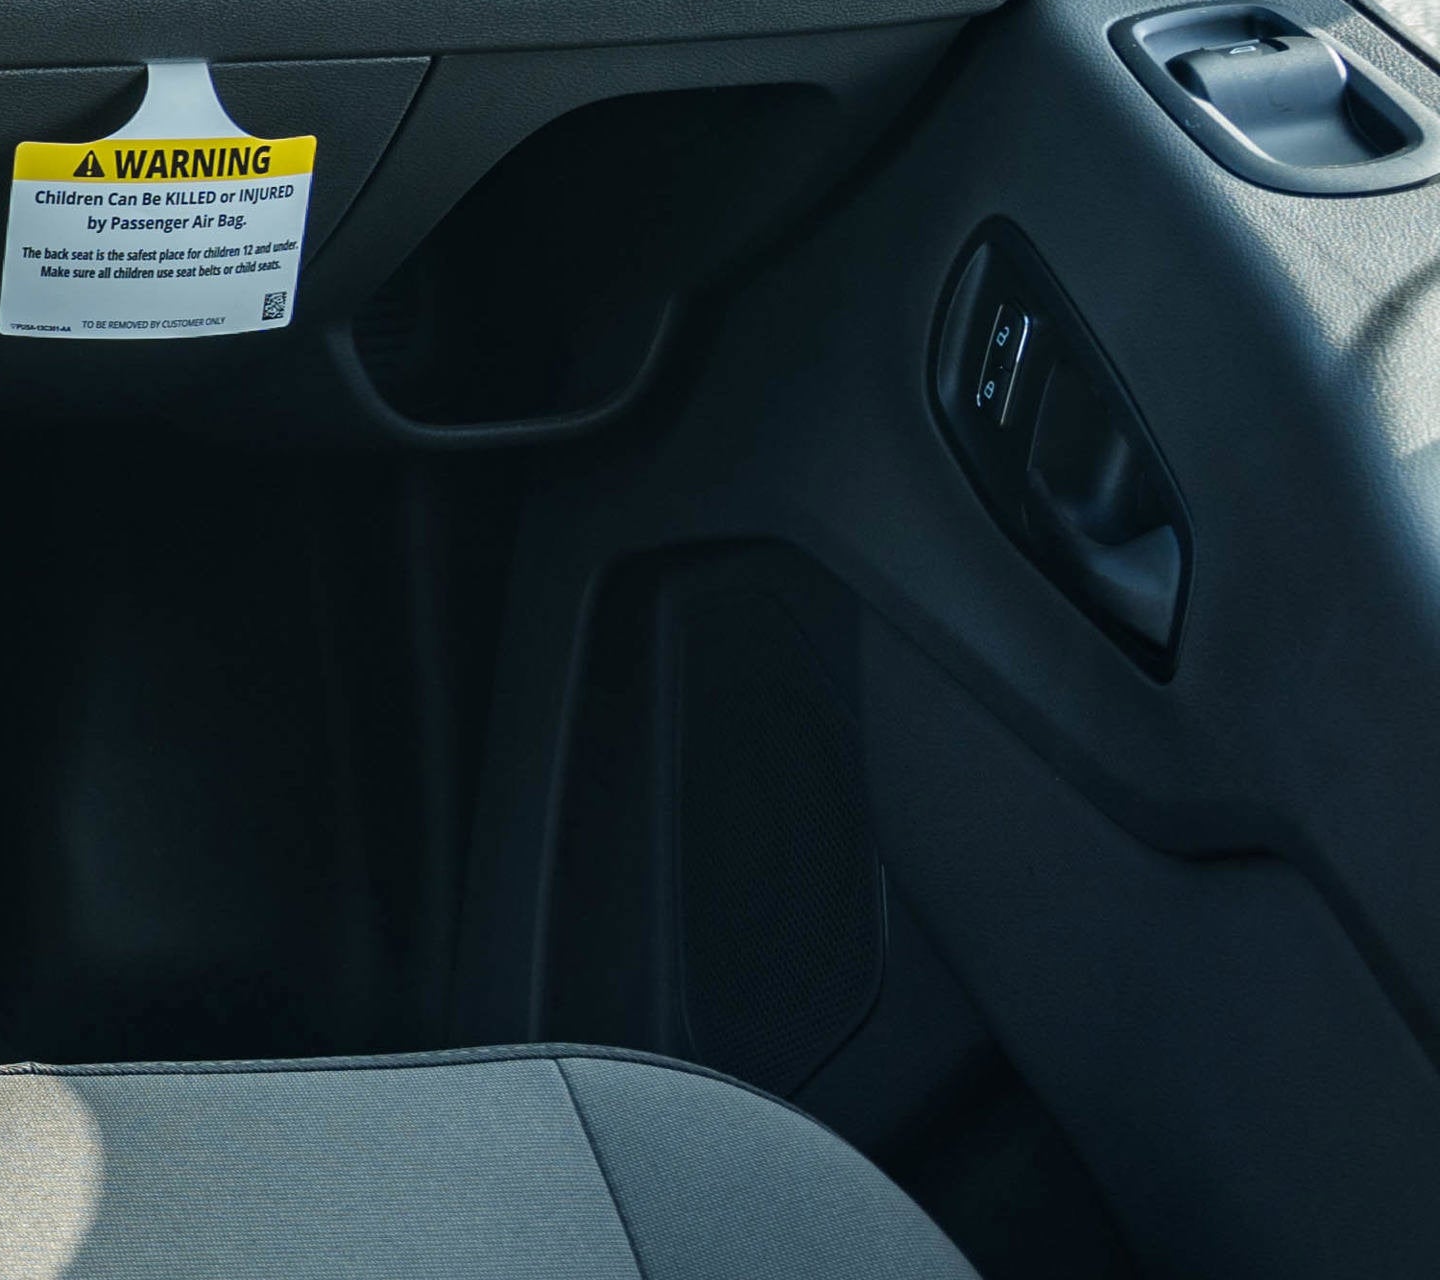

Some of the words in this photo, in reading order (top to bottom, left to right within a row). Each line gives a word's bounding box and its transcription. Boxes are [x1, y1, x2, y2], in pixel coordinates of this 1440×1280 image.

[114, 144, 272, 179] WARNING
[35, 190, 103, 206] Children
[108, 192, 137, 206] Can
[142, 192, 162, 206] Be
[165, 191, 217, 206] KILLED
[220, 191, 235, 203] or
[239, 184, 294, 205] INJURED
[87, 215, 107, 234] by
[111, 215, 189, 234] Passenger
[192, 214, 215, 228] Air
[217, 213, 247, 230] Bag.
[22, 246, 41, 259] The
[44, 247, 69, 260] back
[71, 248, 93, 261] seat
[96, 248, 105, 261] is
[107, 248, 124, 261] the
[126, 248, 157, 262] safest
[159, 248, 185, 264] place
[186, 247, 201, 259] for
[203, 245, 240, 259] children
[243, 244, 253, 256] 12
[255, 242, 271, 255] and
[273, 239, 299, 253] under.
[40, 266, 70, 278] Make
[72, 267, 95, 279] sure
[98, 267, 111, 279] all
[114, 266, 154, 279] children
[157, 268, 174, 279] use
[176, 266, 196, 278] seat
[199, 264, 221, 277] belts
[223, 265, 233, 275] or
[235, 261, 256, 274] child
[257, 259, 281, 272] seats.
[81, 319, 94, 329] TO
[95, 320, 107, 329] BE
[108, 319, 149, 330] REMOVED
[150, 319, 161, 329] BY
[161, 318, 204, 329] CUSTOMER
[205, 316, 226, 327] ONLY
